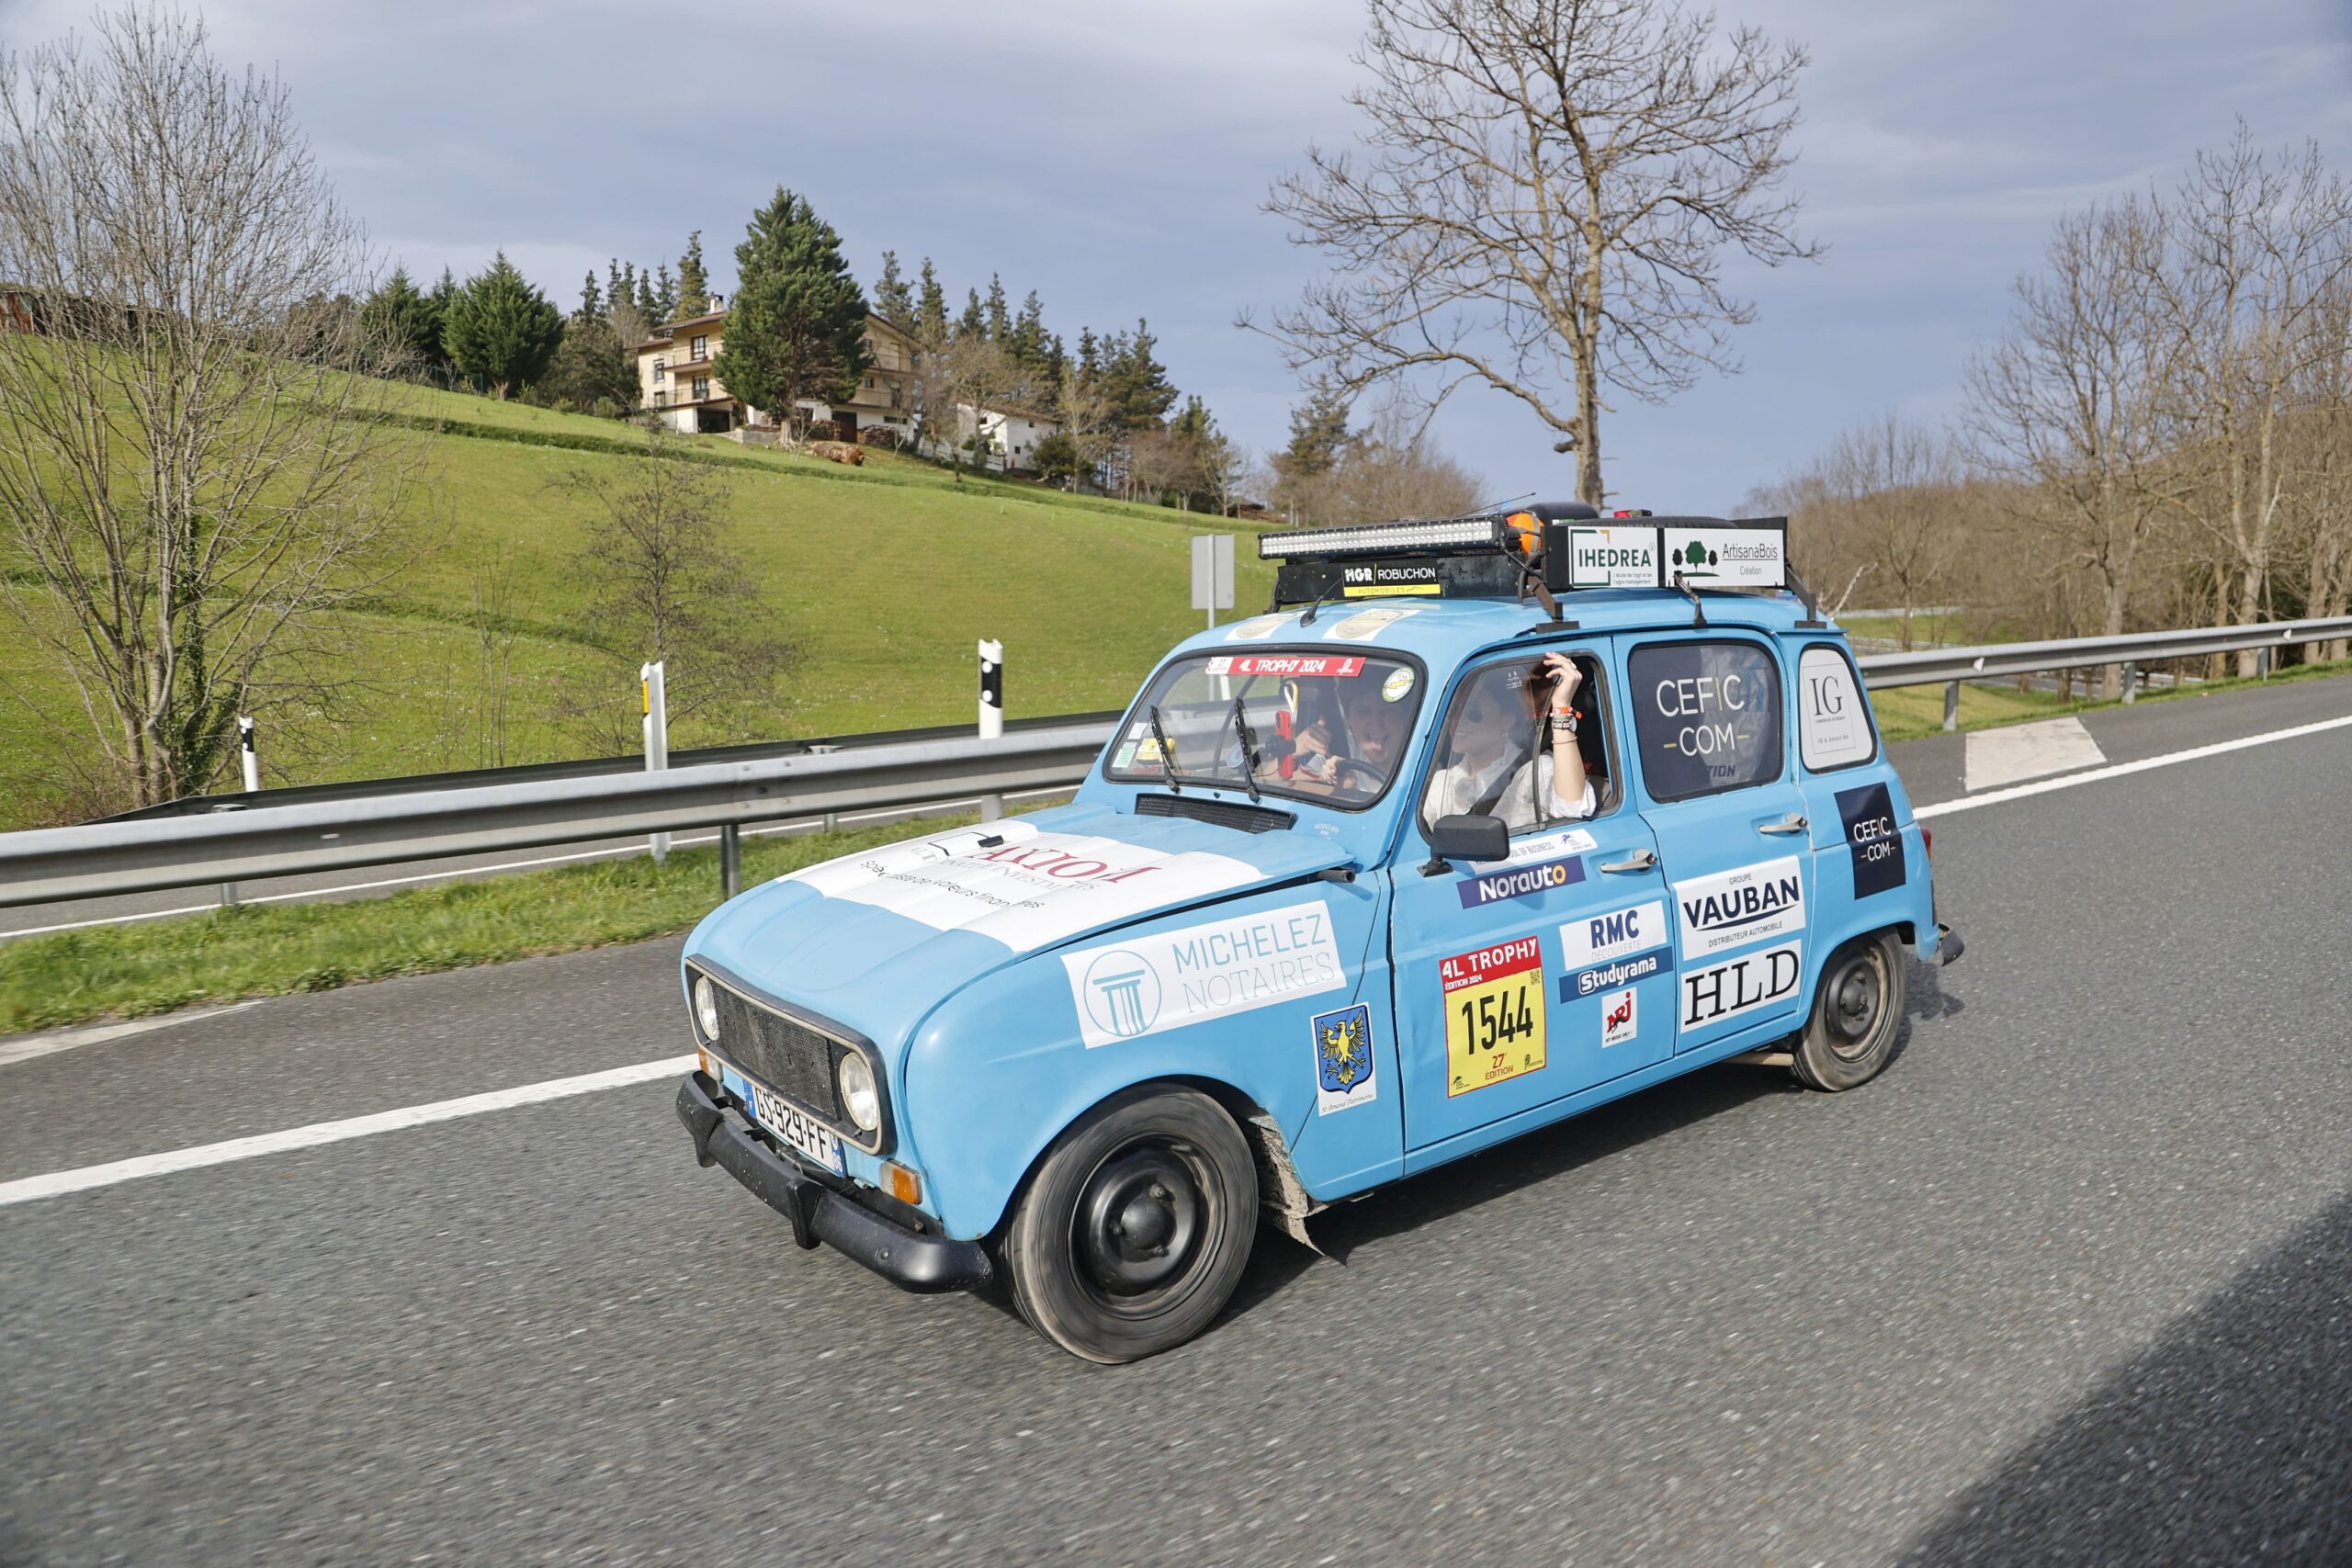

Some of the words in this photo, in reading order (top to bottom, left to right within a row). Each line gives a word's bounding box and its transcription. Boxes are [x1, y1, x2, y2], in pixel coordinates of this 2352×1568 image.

[1578, 548, 1652, 567] IHEDREA
[1723, 543, 1778, 558] ArtisanaBois
[1377, 567, 1436, 581] ROBUCHON
[1239, 660, 1251, 671] 4L
[1255, 660, 1298, 672] TROPHY
[1298, 660, 1327, 672] 2024
[1657, 674, 1745, 717] CEFIC
[1809, 676, 1842, 716] IG
[1521, 846, 1529, 855] OF
[1528, 841, 1555, 854] BUSINESS
[1854, 817, 1891, 842] CEFIC
[1479, 864, 1566, 902] Norauto
[1729, 874, 1752, 885] GROUPE
[1683, 876, 1800, 928] VAUBAN
[1172, 913, 1328, 975] MICHELEZ
[1590, 909, 1640, 950] RMC
[1708, 931, 1748, 947] DISTRIBUTEUR
[1748, 921, 1783, 936] AUTOMOBILE
[1442, 960, 1464, 978] 4L
[1468, 939, 1537, 972] TROPHY
[1579, 957, 1657, 994] Studyrama
[1182, 952, 1335, 1013] NOTAIRES
[1469, 974, 1483, 986] 2024
[1685, 949, 1799, 1026] HLD
[1462, 986, 1533, 1055] 1544
[1485, 1065, 1514, 1080] EDITION
